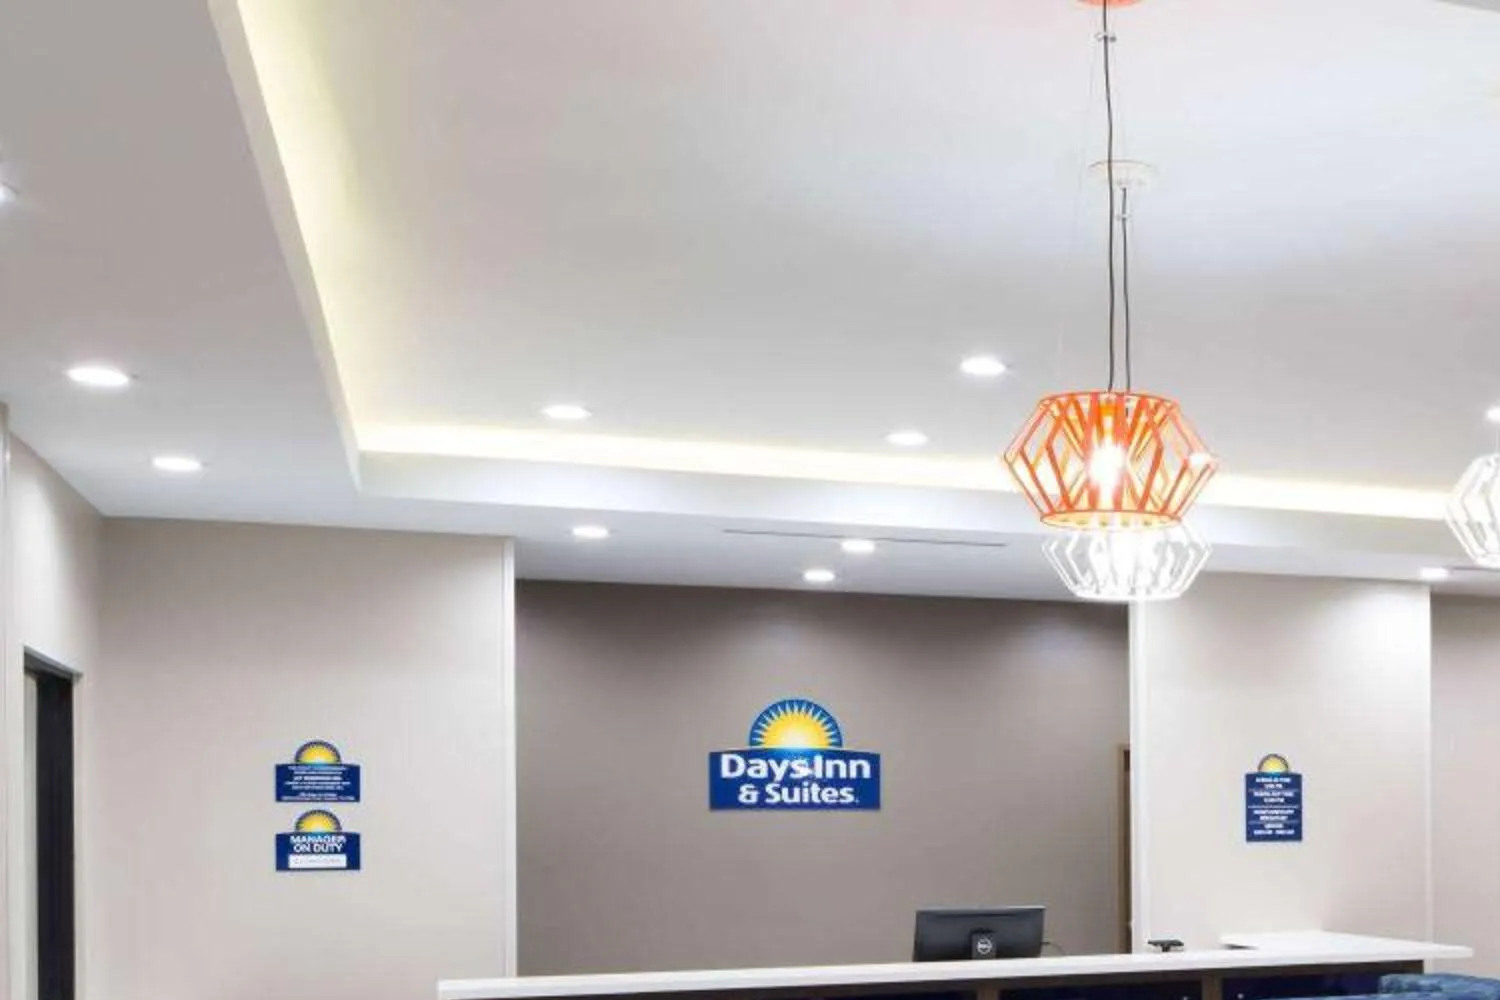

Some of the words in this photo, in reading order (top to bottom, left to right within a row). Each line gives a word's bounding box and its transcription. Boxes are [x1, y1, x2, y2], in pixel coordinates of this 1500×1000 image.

[737, 783, 760, 804] &
[765, 781, 855, 804] Suites
[289, 835, 347, 844] MANAGER
[293, 843, 311, 853] ON
[313, 843, 343, 853] DUTY
